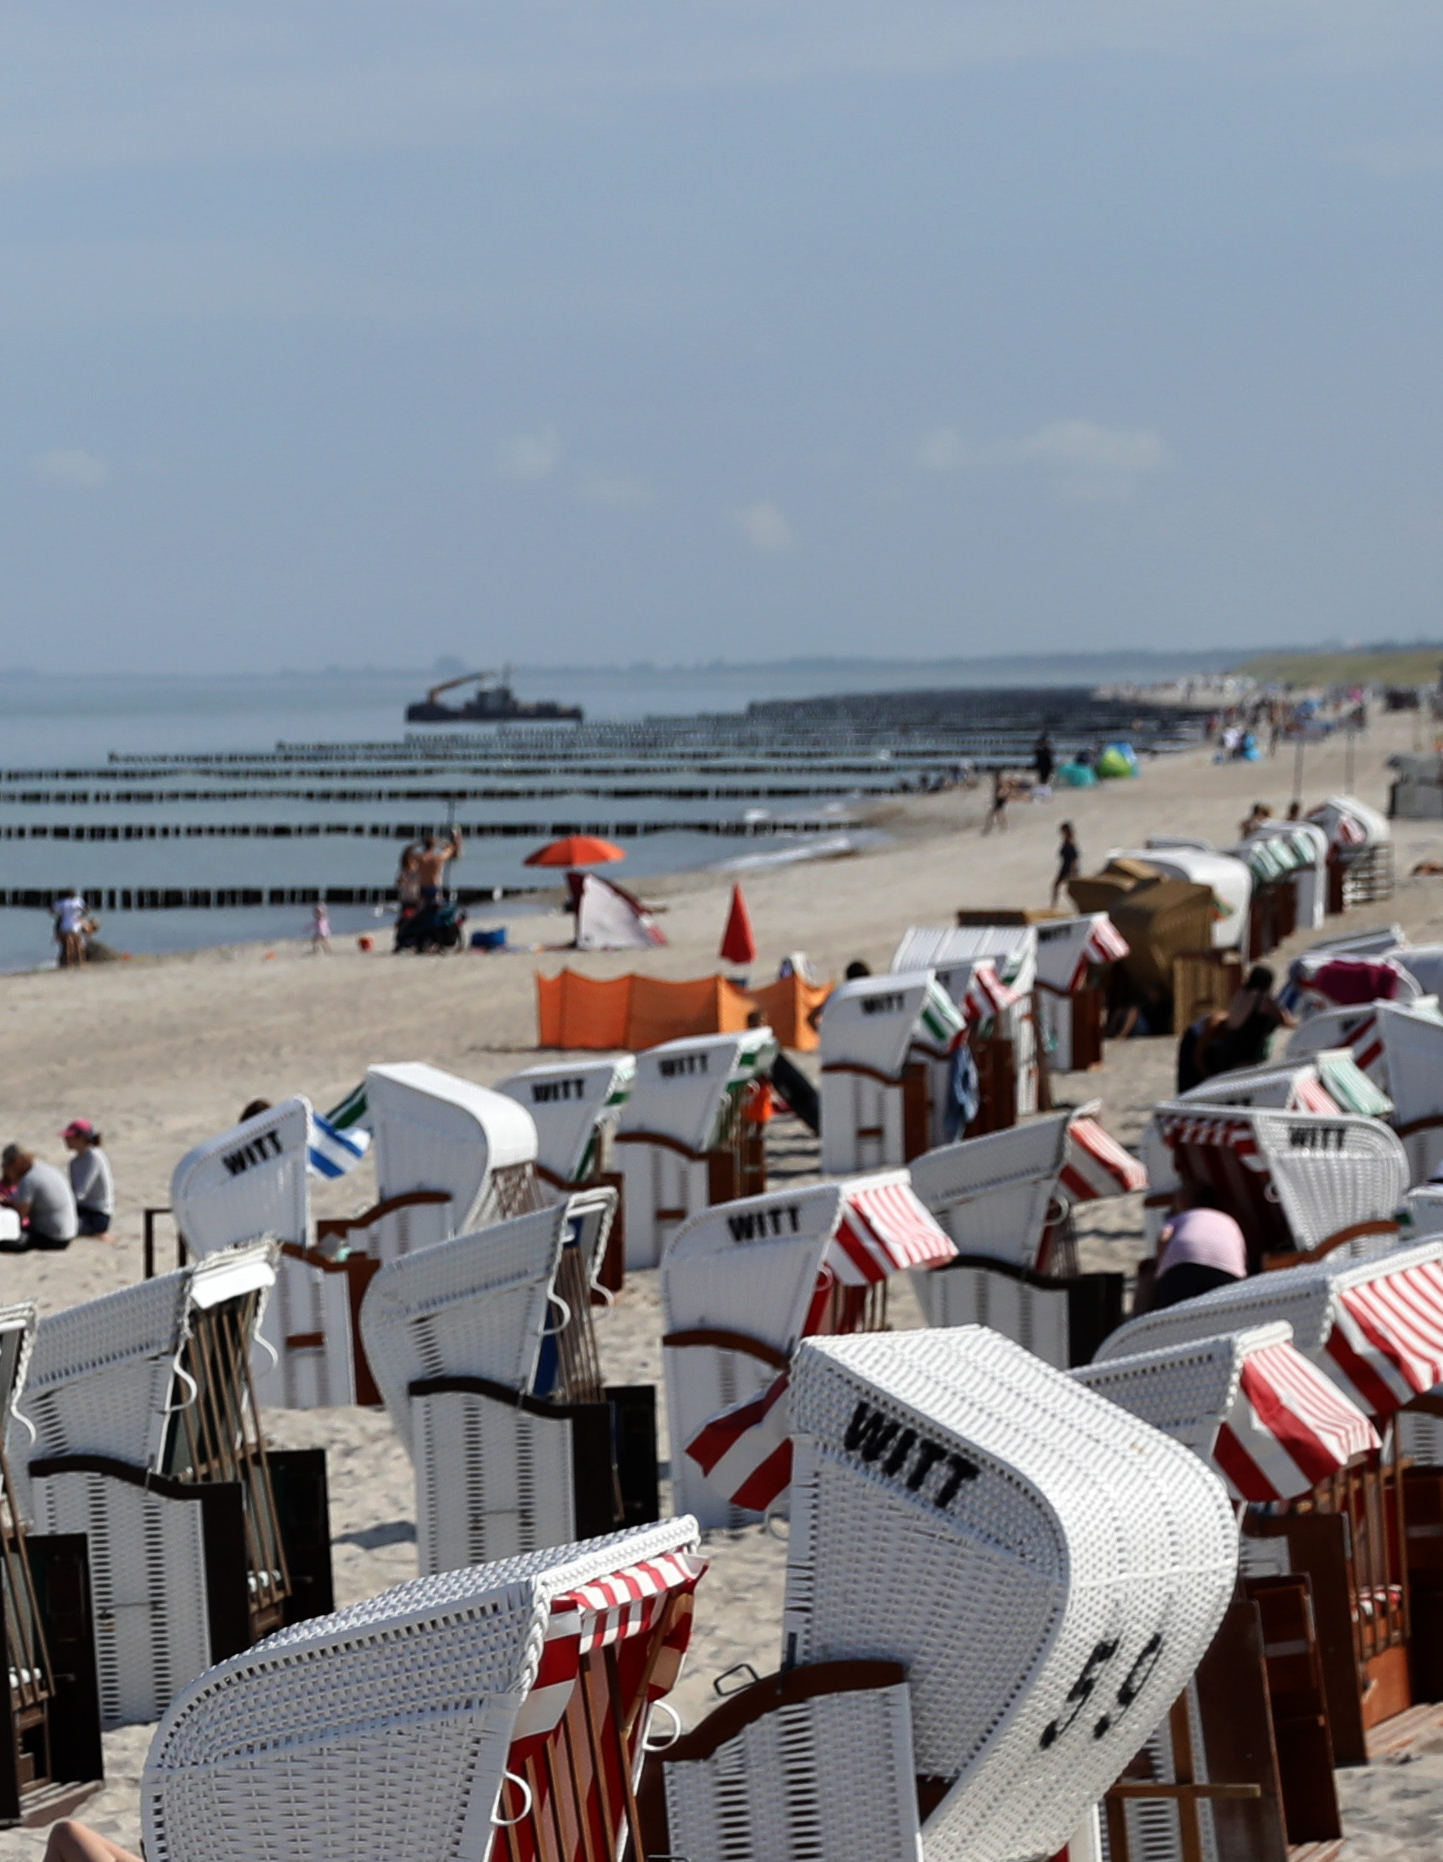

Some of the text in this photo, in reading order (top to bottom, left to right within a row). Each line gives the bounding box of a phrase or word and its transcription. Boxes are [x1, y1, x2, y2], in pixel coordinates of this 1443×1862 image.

[658, 1053, 709, 1077] WITT
[533, 1077, 585, 1103] WITT
[222, 1129, 283, 1177] WITT
[1289, 1126, 1345, 1150] WITT
[727, 1205, 799, 1242] WITT
[843, 1400, 981, 1509] WITT
